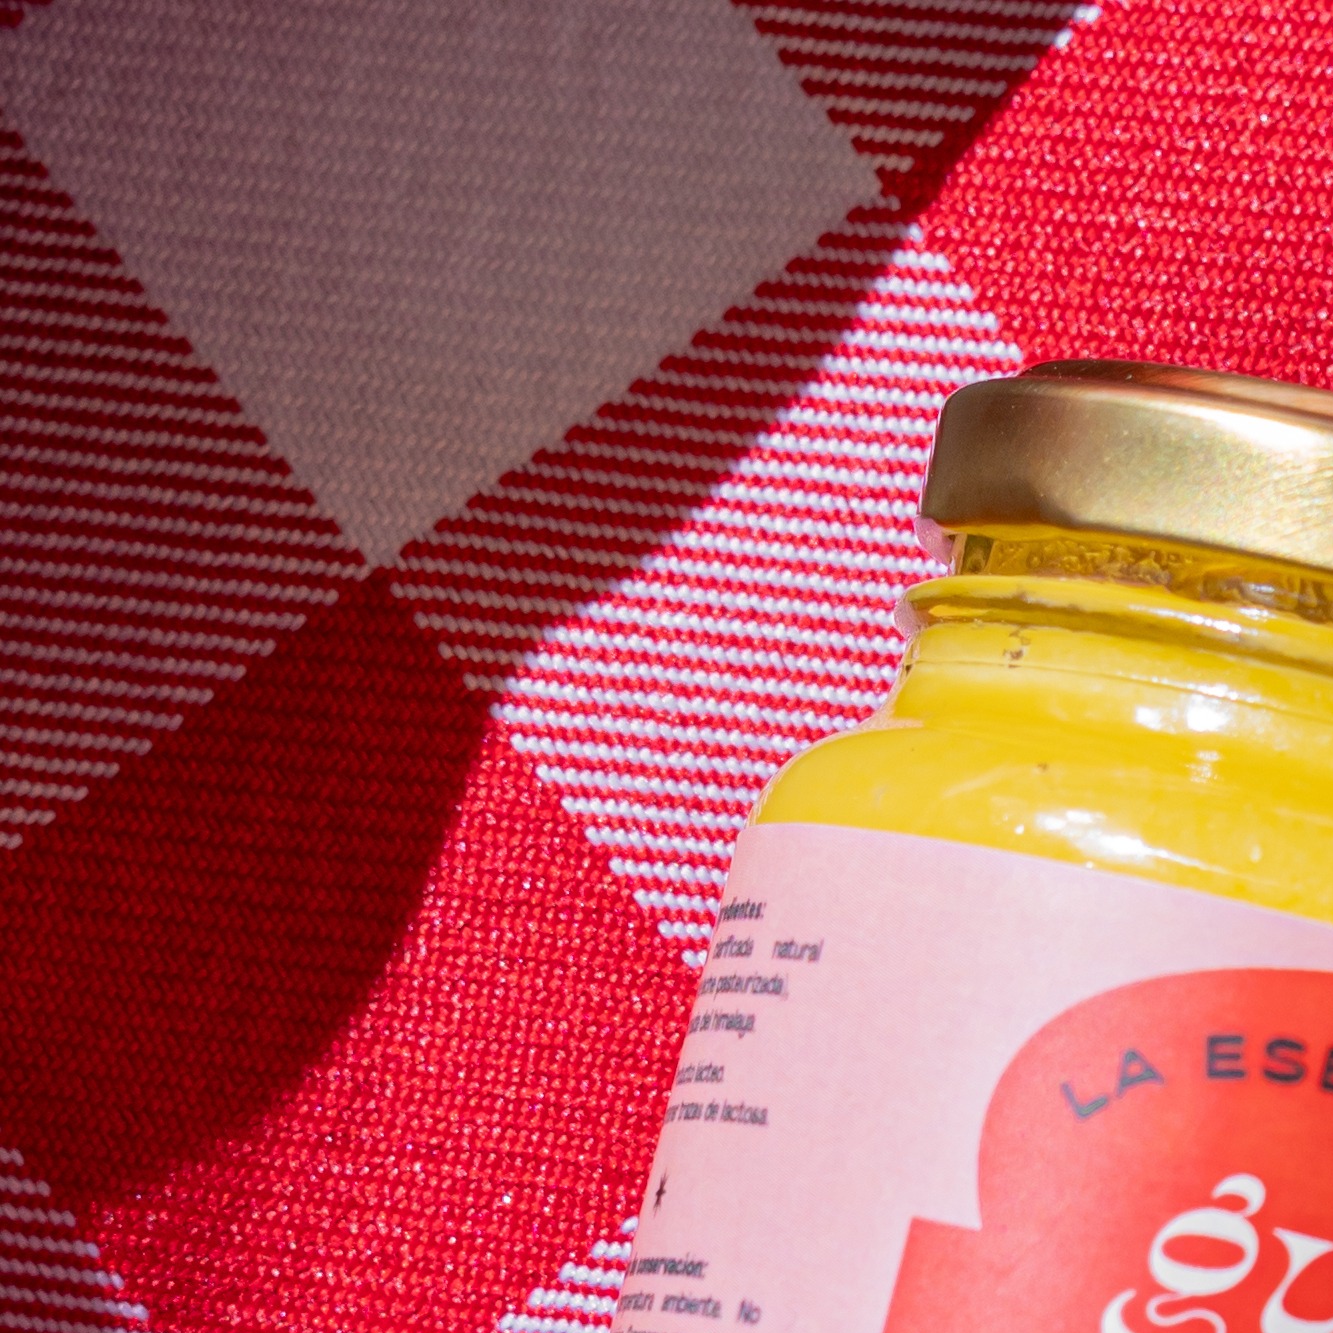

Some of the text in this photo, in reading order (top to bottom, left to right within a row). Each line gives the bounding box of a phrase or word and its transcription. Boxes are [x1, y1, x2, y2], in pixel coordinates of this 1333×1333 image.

[773, 937, 825, 963] natural
[1060, 1048, 1165, 1120] LA
[705, 1097, 719, 1121] de
[738, 1300, 761, 1324] No
